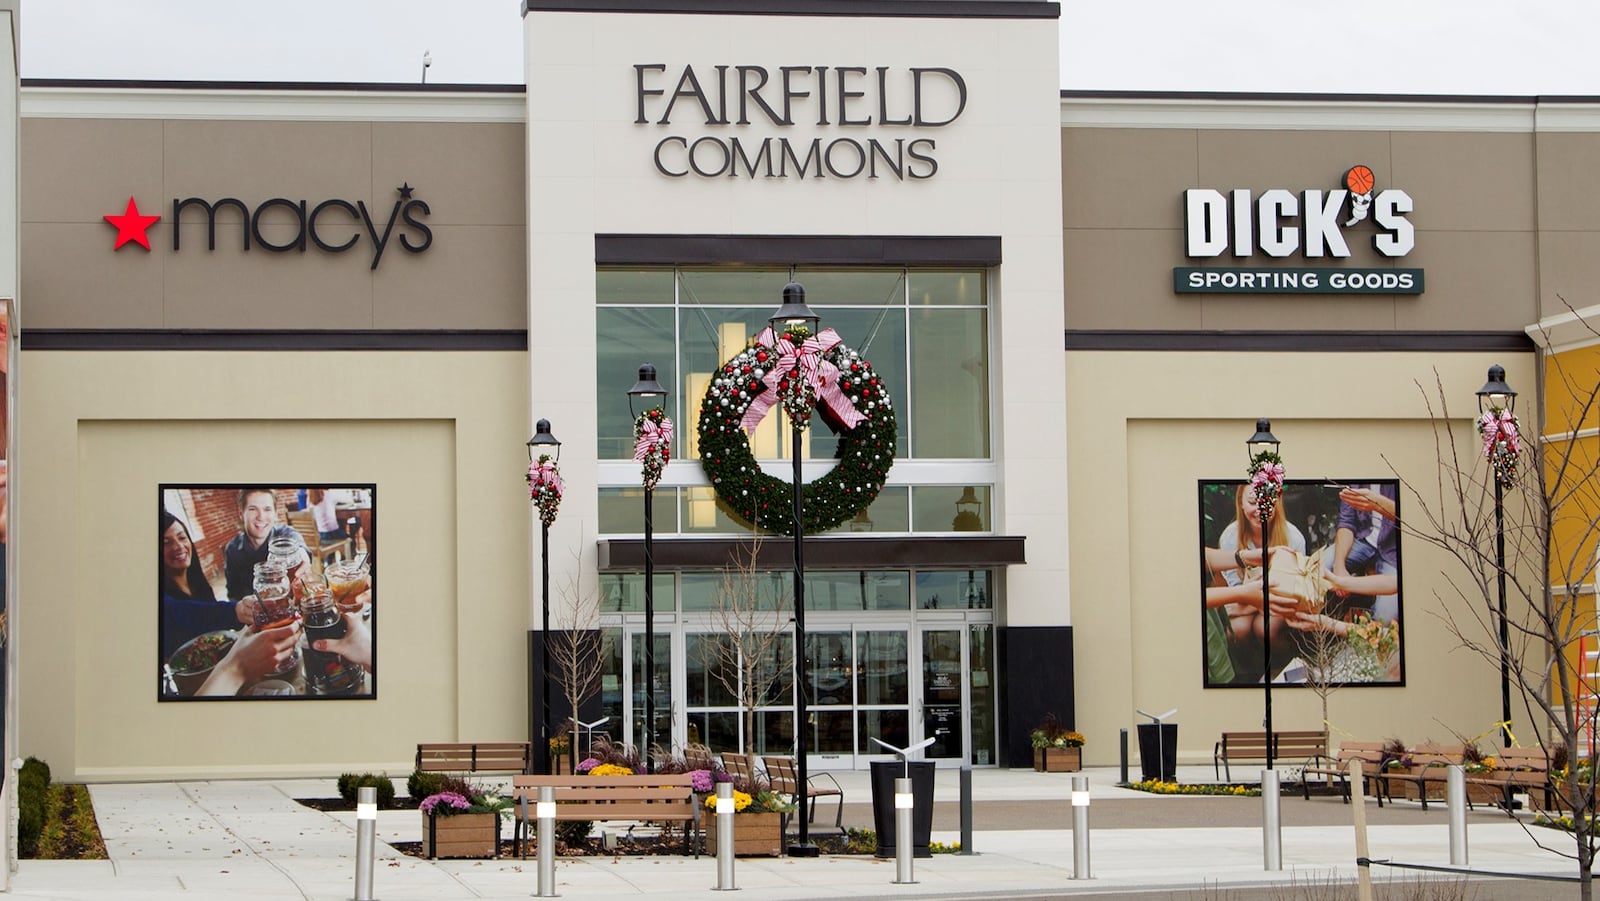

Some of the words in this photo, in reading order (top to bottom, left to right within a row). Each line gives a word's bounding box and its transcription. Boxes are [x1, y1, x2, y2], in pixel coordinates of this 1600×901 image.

[632, 63, 967, 127] FAIRFIELD
[653, 136, 938, 181] COMMONS
[173, 181, 433, 270] macy's
[1184, 165, 1416, 258] DICK'S
[1188, 272, 1319, 289] SPORTING
[1328, 272, 1414, 290] GOODS
